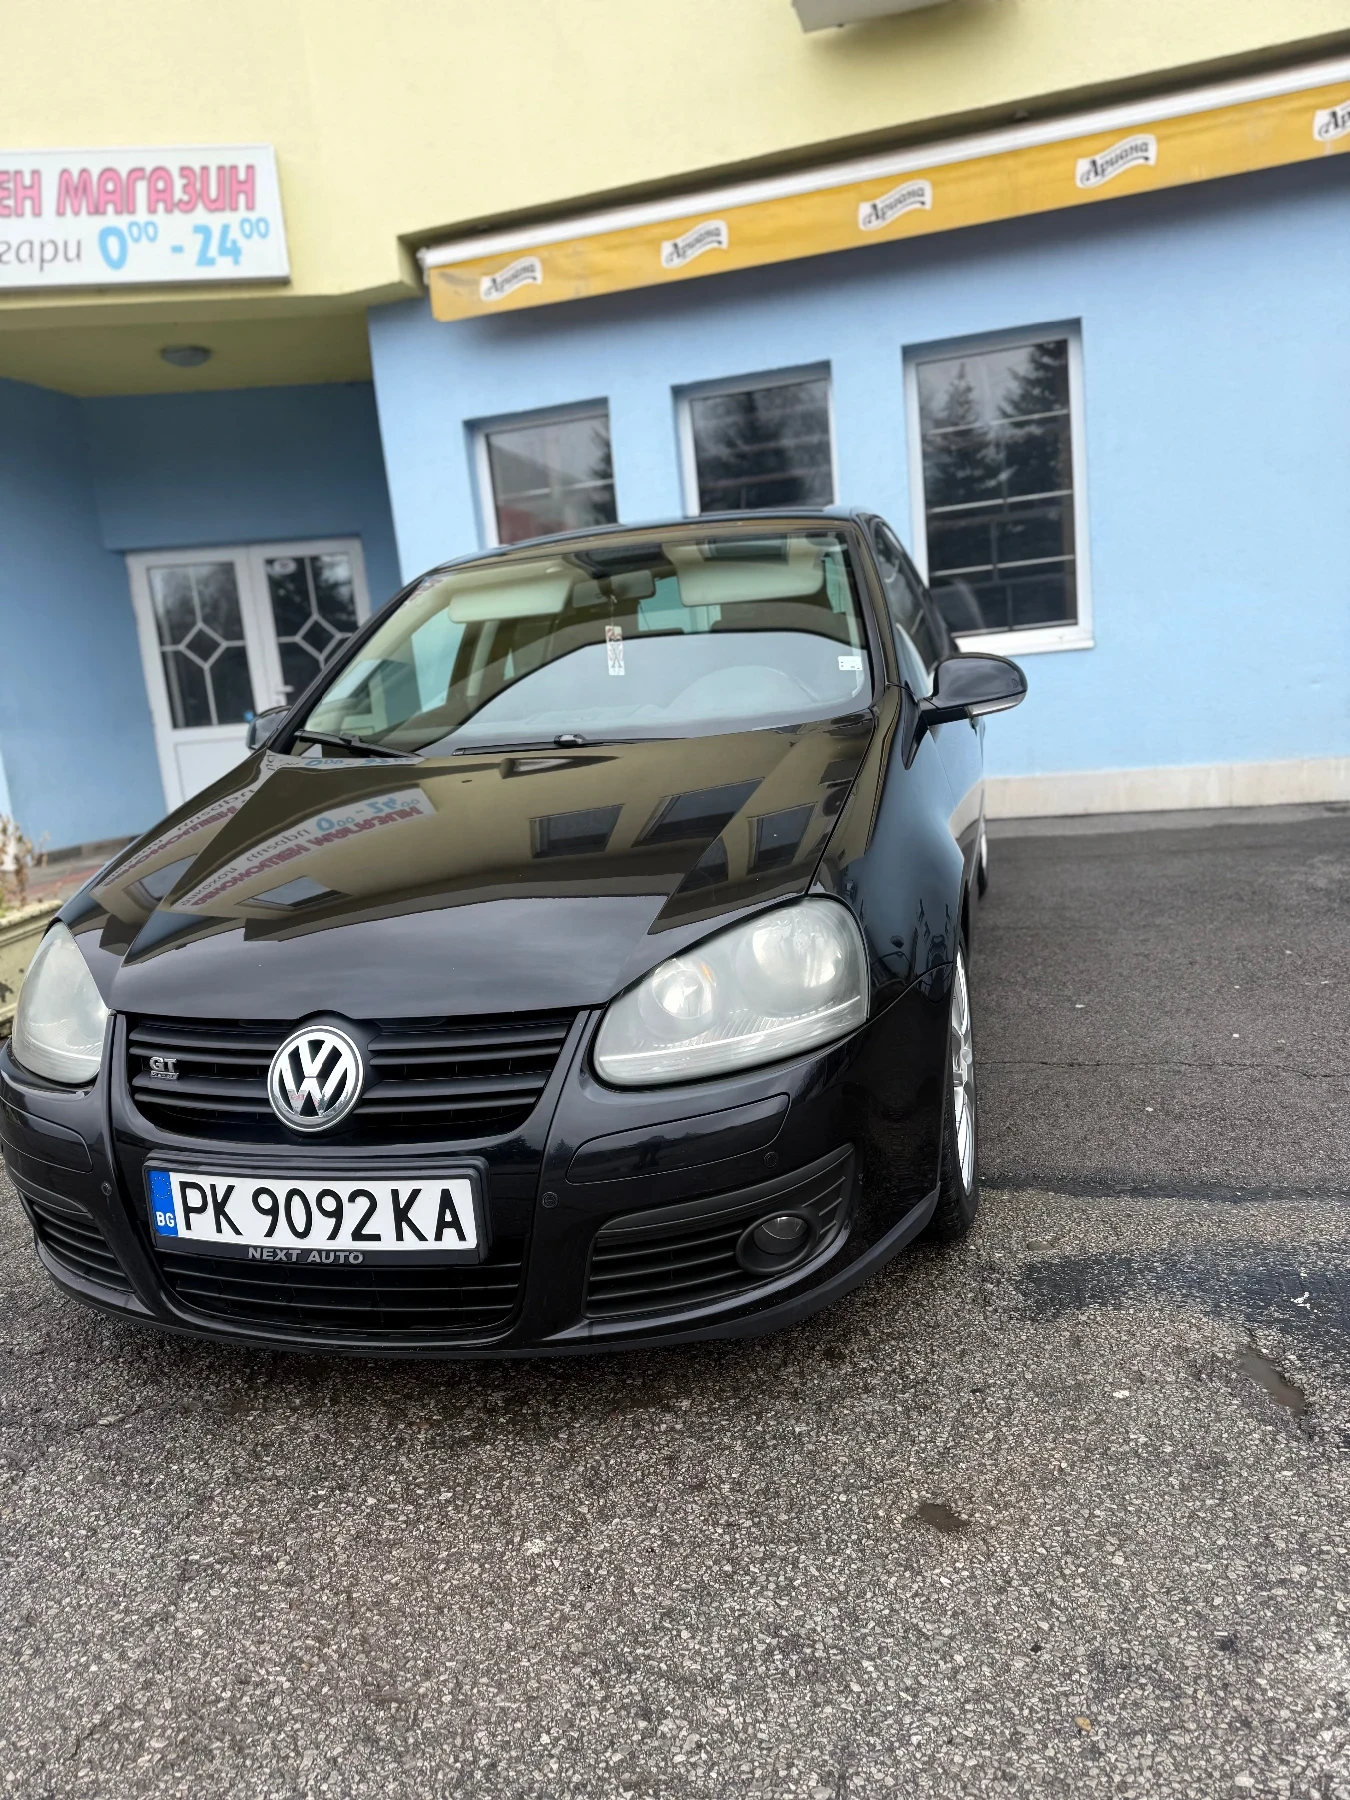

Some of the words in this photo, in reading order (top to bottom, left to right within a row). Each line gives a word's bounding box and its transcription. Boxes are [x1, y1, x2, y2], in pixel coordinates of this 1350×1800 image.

[56, 164, 256, 217] МАГАЗИН
[149, 1056, 177, 1073] GT
[156, 1211, 175, 1227] BG
[251, 1186, 382, 1242] 9092
[248, 1247, 301, 1262] NEXT
[306, 1250, 364, 1264] AUTO
